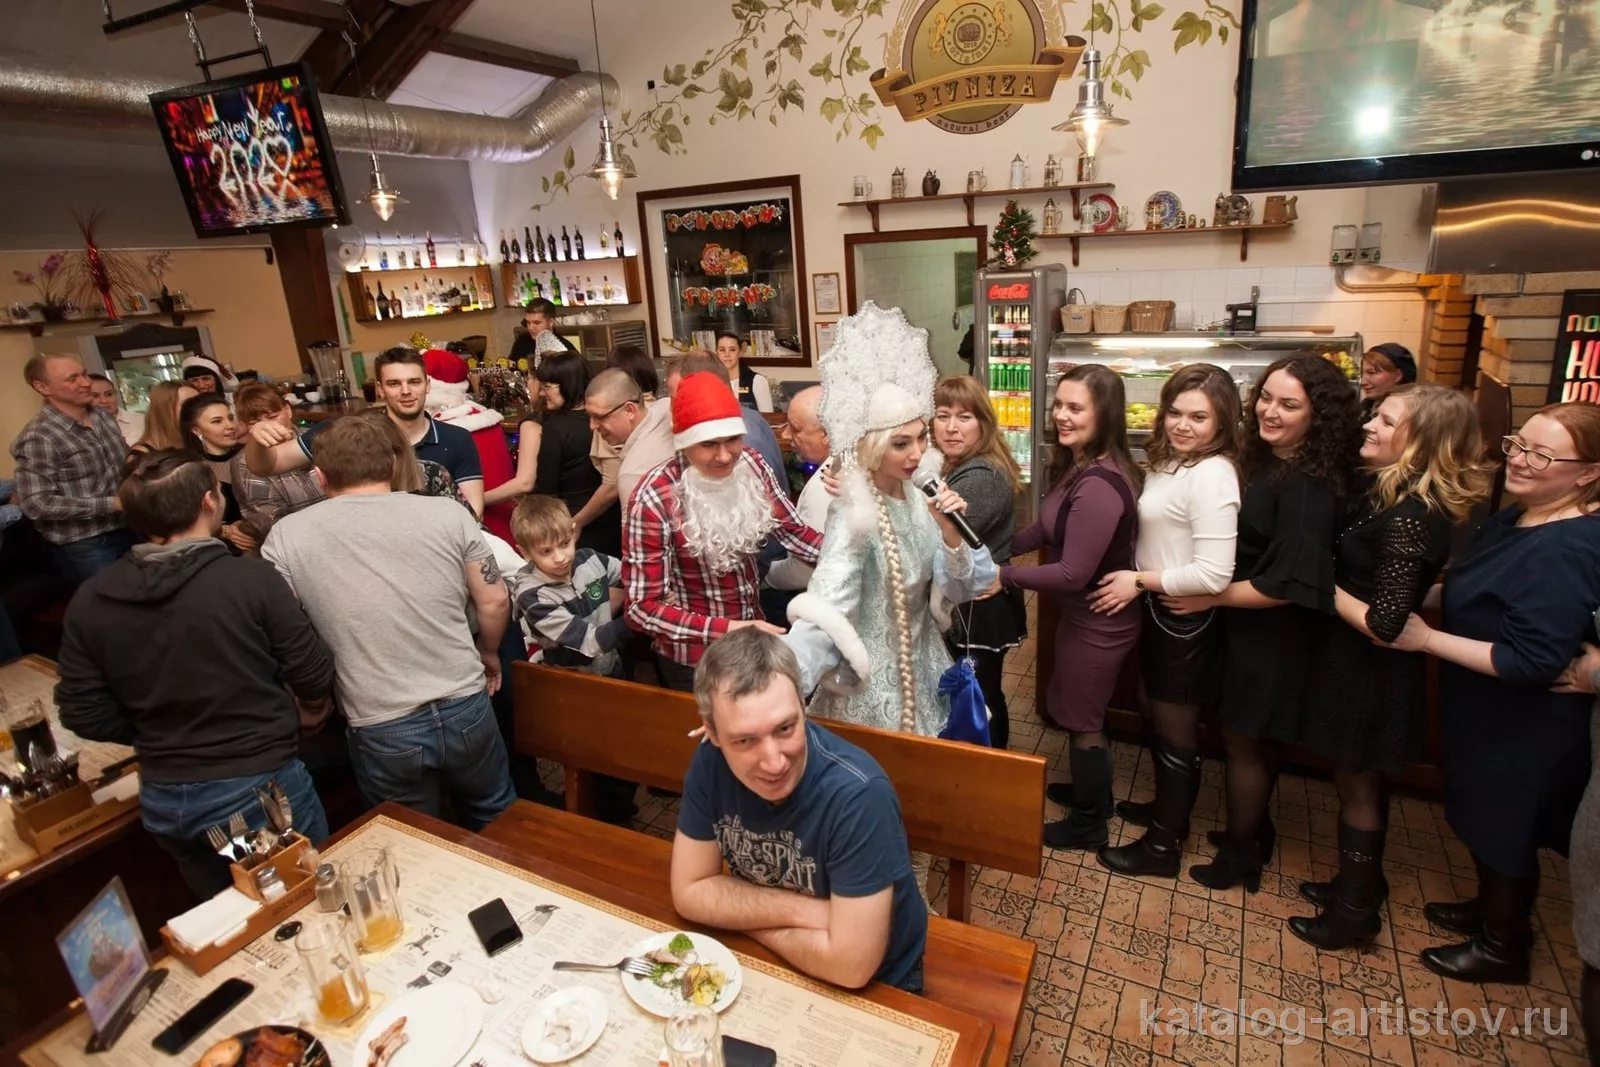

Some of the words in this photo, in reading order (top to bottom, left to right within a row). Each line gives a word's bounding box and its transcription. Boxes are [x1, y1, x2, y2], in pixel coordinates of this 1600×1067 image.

[913, 74, 1037, 113] PIVNIZA
[196, 124, 222, 144] Happy
[222, 118, 250, 140] New
[936, 118, 979, 132] natural
[986, 110, 1010, 128] beer
